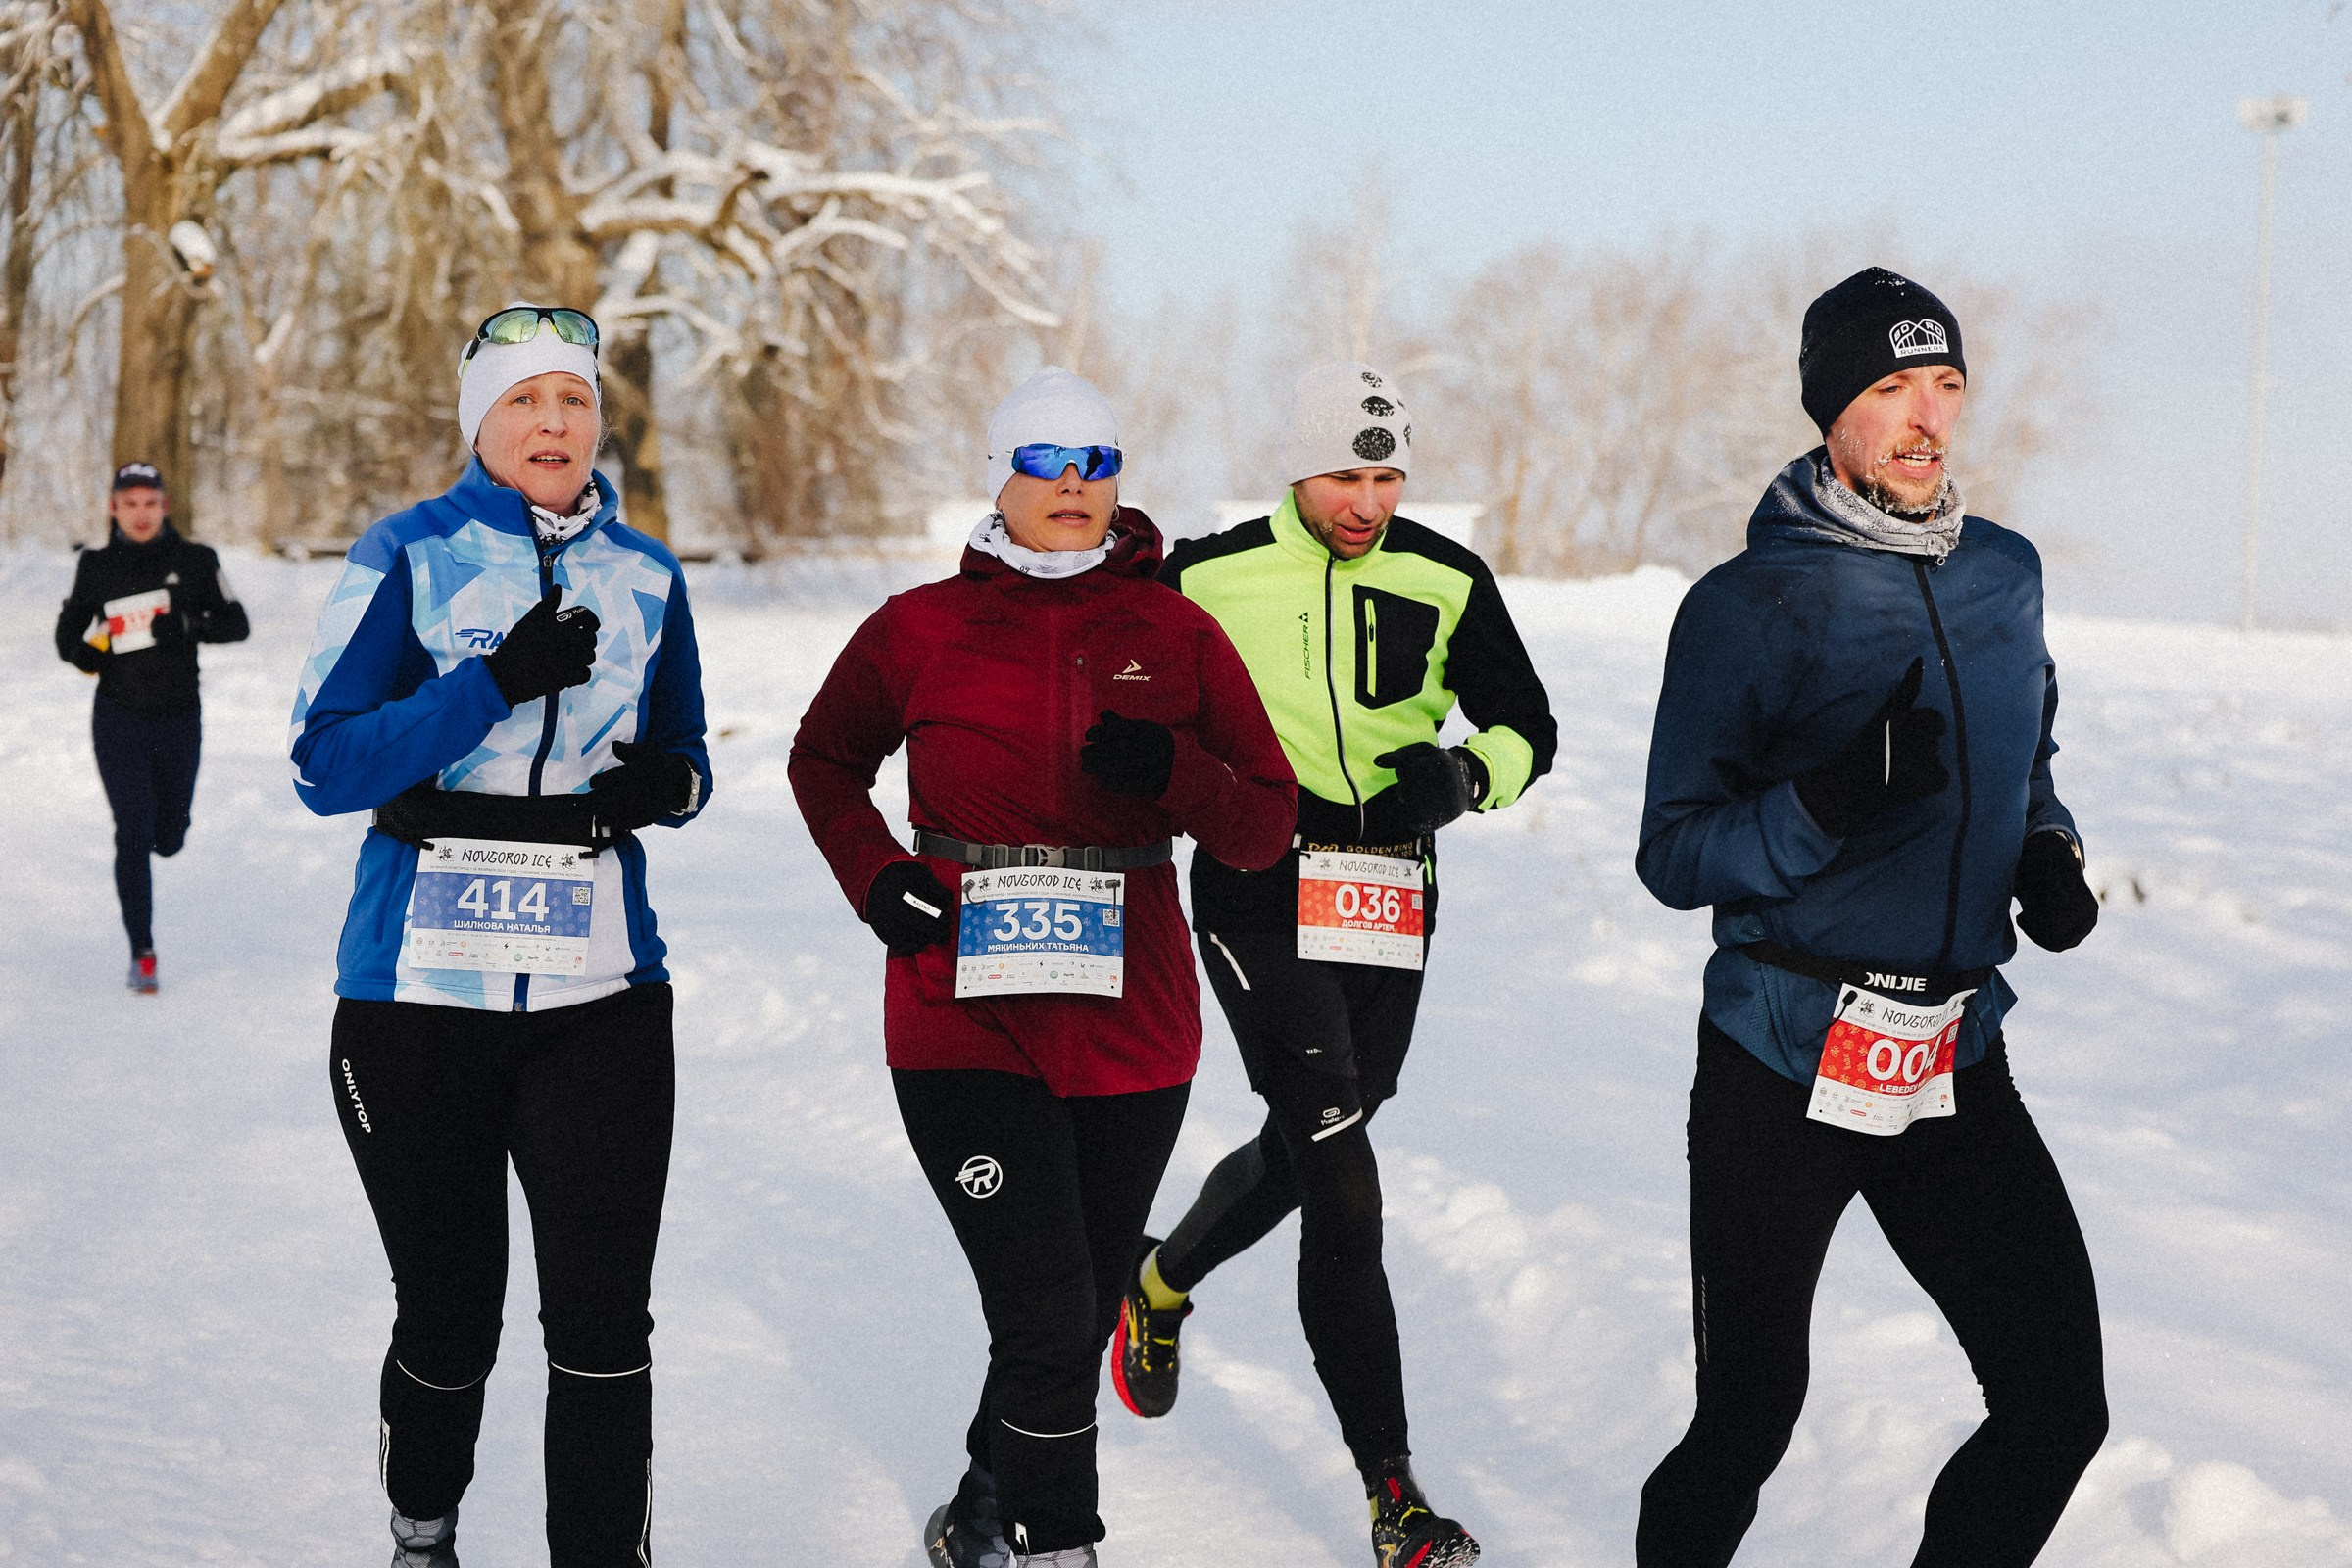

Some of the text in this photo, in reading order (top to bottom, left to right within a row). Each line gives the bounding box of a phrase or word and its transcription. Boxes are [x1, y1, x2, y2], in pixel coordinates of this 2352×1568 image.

[1900, 346, 1944, 355] RUNNERS
[456, 628, 510, 650] RA
[1302, 624, 1311, 680] FISCHER
[462, 849, 552, 869] NOVGOROD ICE
[1346, 845, 1392, 854] GOLDEN
[1339, 860, 1399, 878] NOVGOROD ICE
[997, 874, 1082, 891] NOVGOROD ICE
[457, 878, 550, 922] 414
[1334, 884, 1401, 923] 036
[454, 919, 551, 933] ШИЛКОВА НАТАЛЬЯ
[993, 902, 1083, 942] 335
[1342, 919, 1395, 932] ДОЛГОВ АРТЕМ
[987, 942, 1089, 953] МЯКИНЬКИХ ТАТЬЯНА
[1866, 1034, 1942, 1084] 004
[342, 1058, 371, 1133] ONLYTOP
